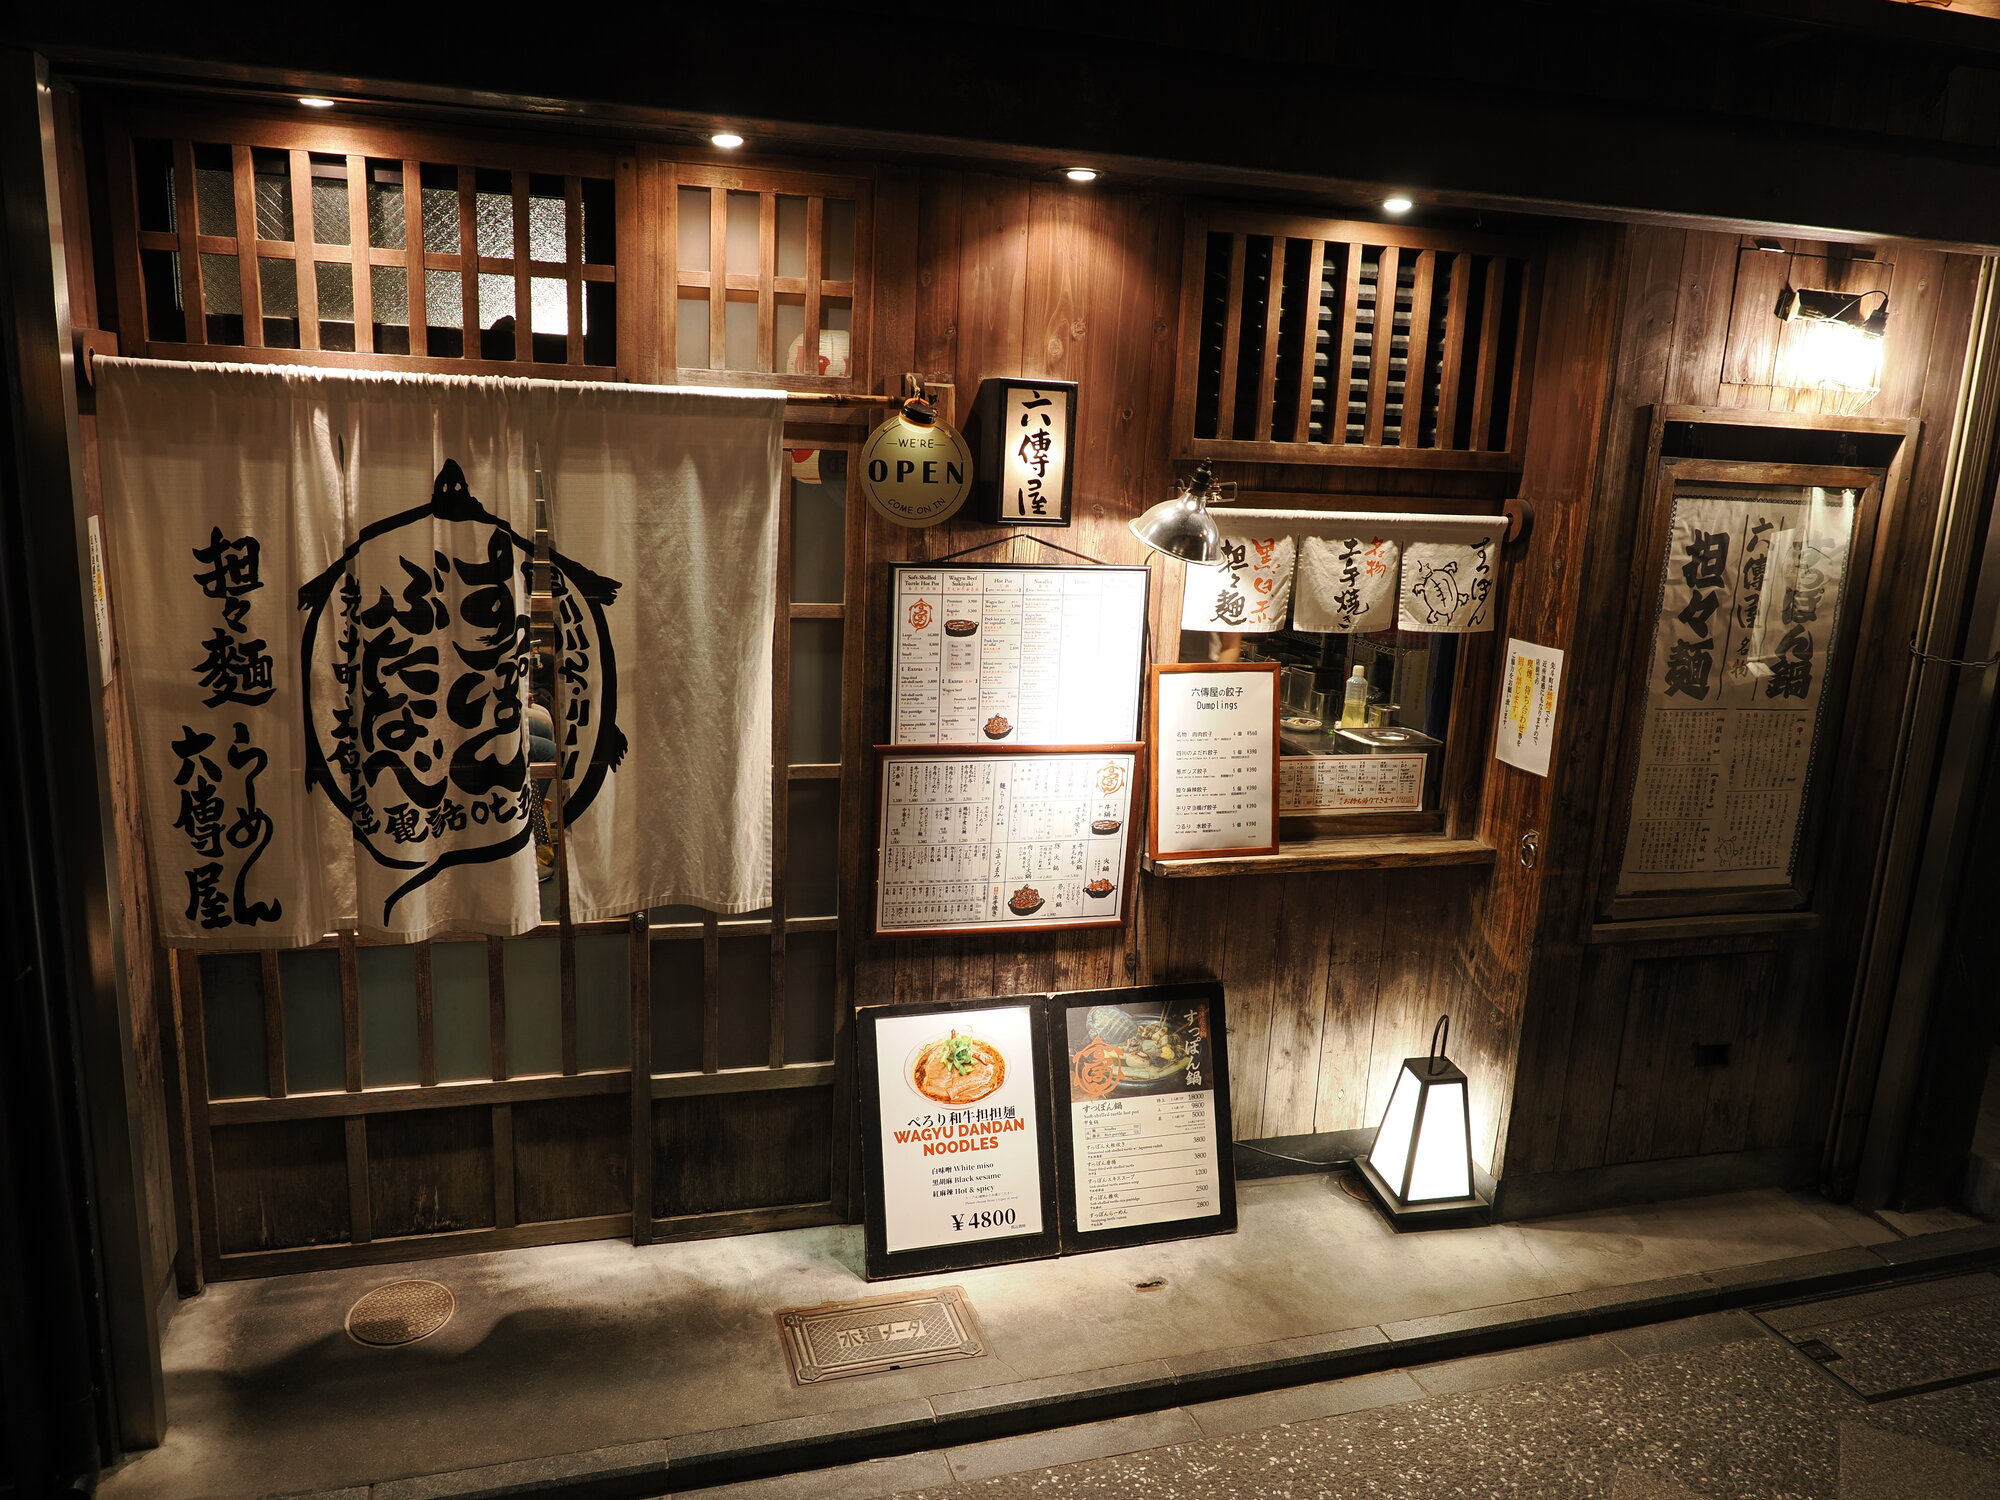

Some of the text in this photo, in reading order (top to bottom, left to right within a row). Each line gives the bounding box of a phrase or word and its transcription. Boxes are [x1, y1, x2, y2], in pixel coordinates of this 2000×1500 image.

[898, 438, 935, 449] WE'RE
[868, 459, 964, 485] OPEN
[888, 497, 946, 515] COME ON IN
[1364, 535, 1387, 579] 名物
[1333, 537, 1369, 629] 土手焼き
[1730, 637, 1751, 679] 名物
[1191, 686, 1244, 698] 六傳屋の餃子
[1196, 700, 1238, 711] Dumplings
[226, 722, 282, 926] らーめん
[1184, 1009, 1202, 1086] すっぽん鍋
[1082, 1101, 1123, 1113] すっぽん鍋
[1188, 1093, 1205, 1101] 18000
[1192, 1110, 1205, 1118] 5000
[893, 1118, 1025, 1144] WAGYU DANDAN
[1193, 1135, 1206, 1143] 3800
[923, 1136, 999, 1156] NOODLES
[1194, 1152, 1207, 1160] 3800
[953, 1164, 976, 1172] White
[976, 1162, 994, 1170] miso
[1195, 1168, 1208, 1176] 1200
[954, 1175, 974, 1183] Black
[975, 1173, 1002, 1181] sesame
[976, 1184, 995, 1193] spicy
[1197, 1201, 1210, 1209] 2800
